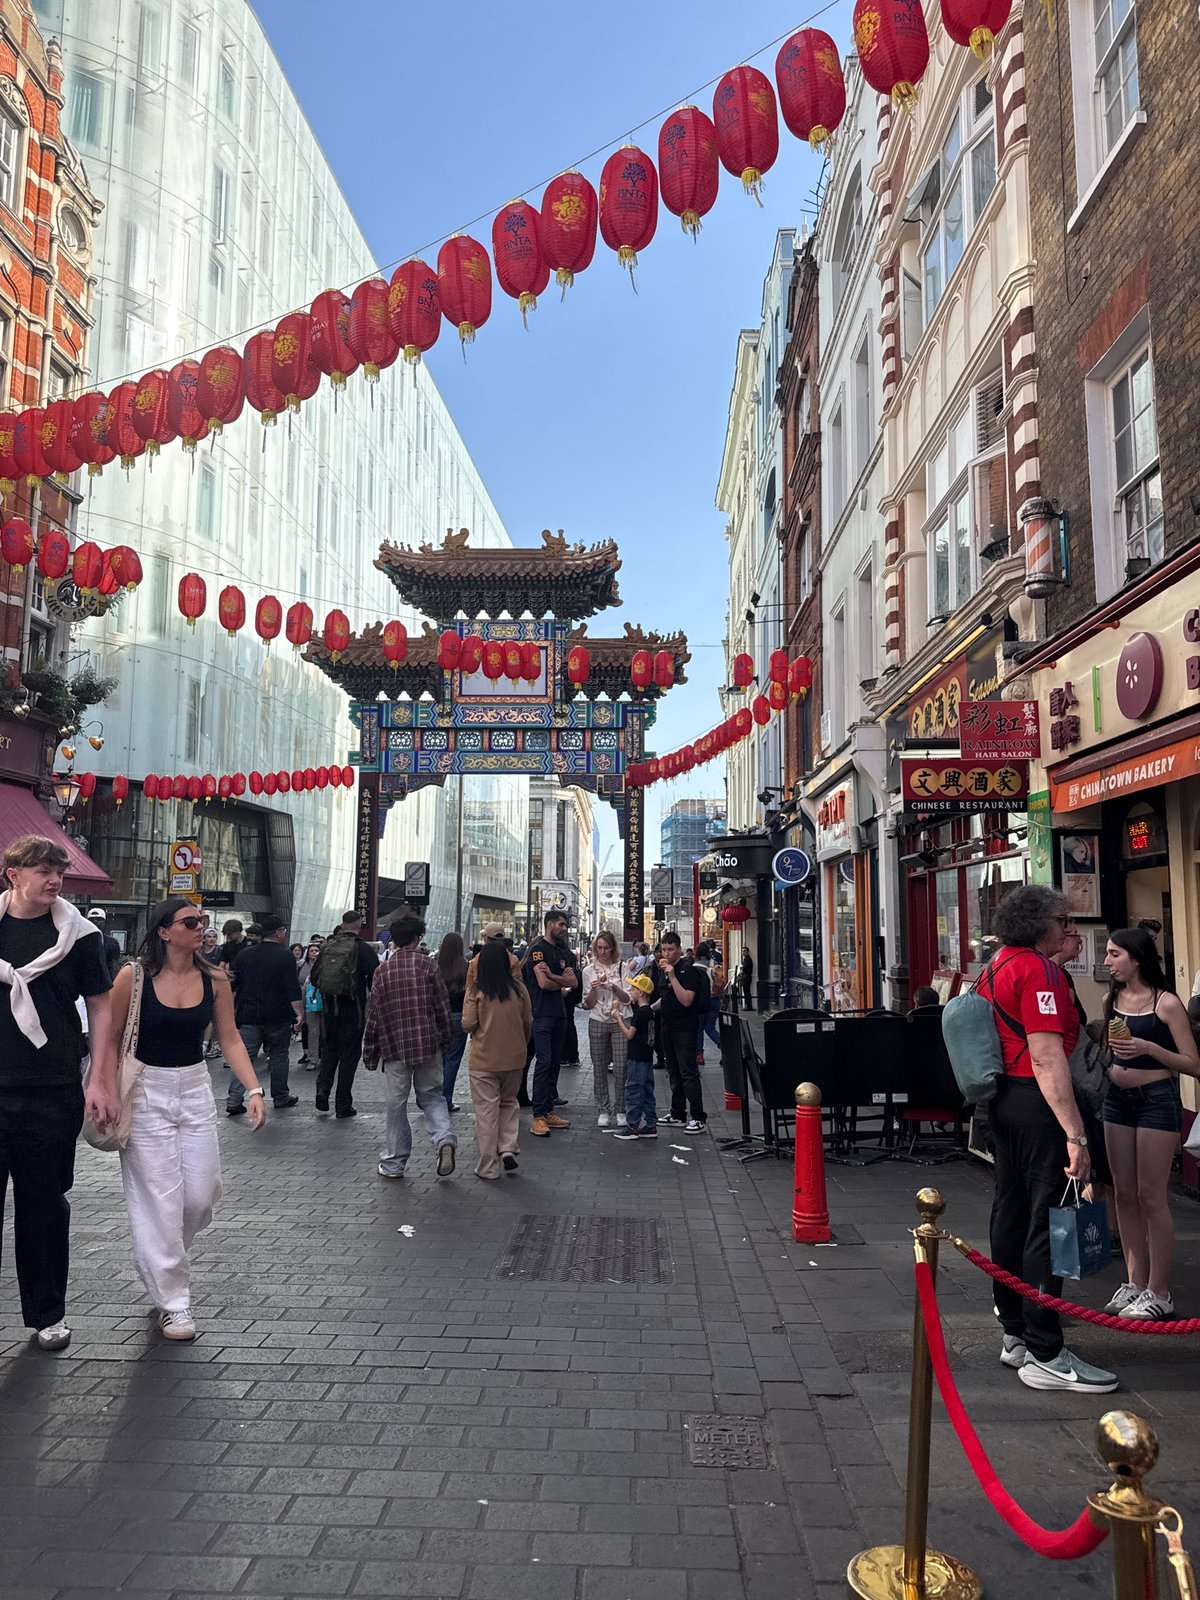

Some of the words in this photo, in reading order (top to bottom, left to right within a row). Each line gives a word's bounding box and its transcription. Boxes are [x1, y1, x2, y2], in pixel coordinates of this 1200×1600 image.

[617, 188, 647, 200] BNTA
[503, 236, 532, 250] BNTA
[962, 703, 1024, 735] 彩虹
[963, 739, 1038, 750] RAINBOW
[913, 769, 1016, 794] 文興酒家
[1080, 769, 1132, 800] CHINATOWN
[1134, 754, 1176, 783] BAKERY
[911, 801, 951, 810] CHINESE
[960, 801, 1025, 810] RESTAURANT
[1129, 821, 1148, 836] HAIR
[1132, 835, 1148, 849] CUT
[694, 1432, 760, 1446] METER
